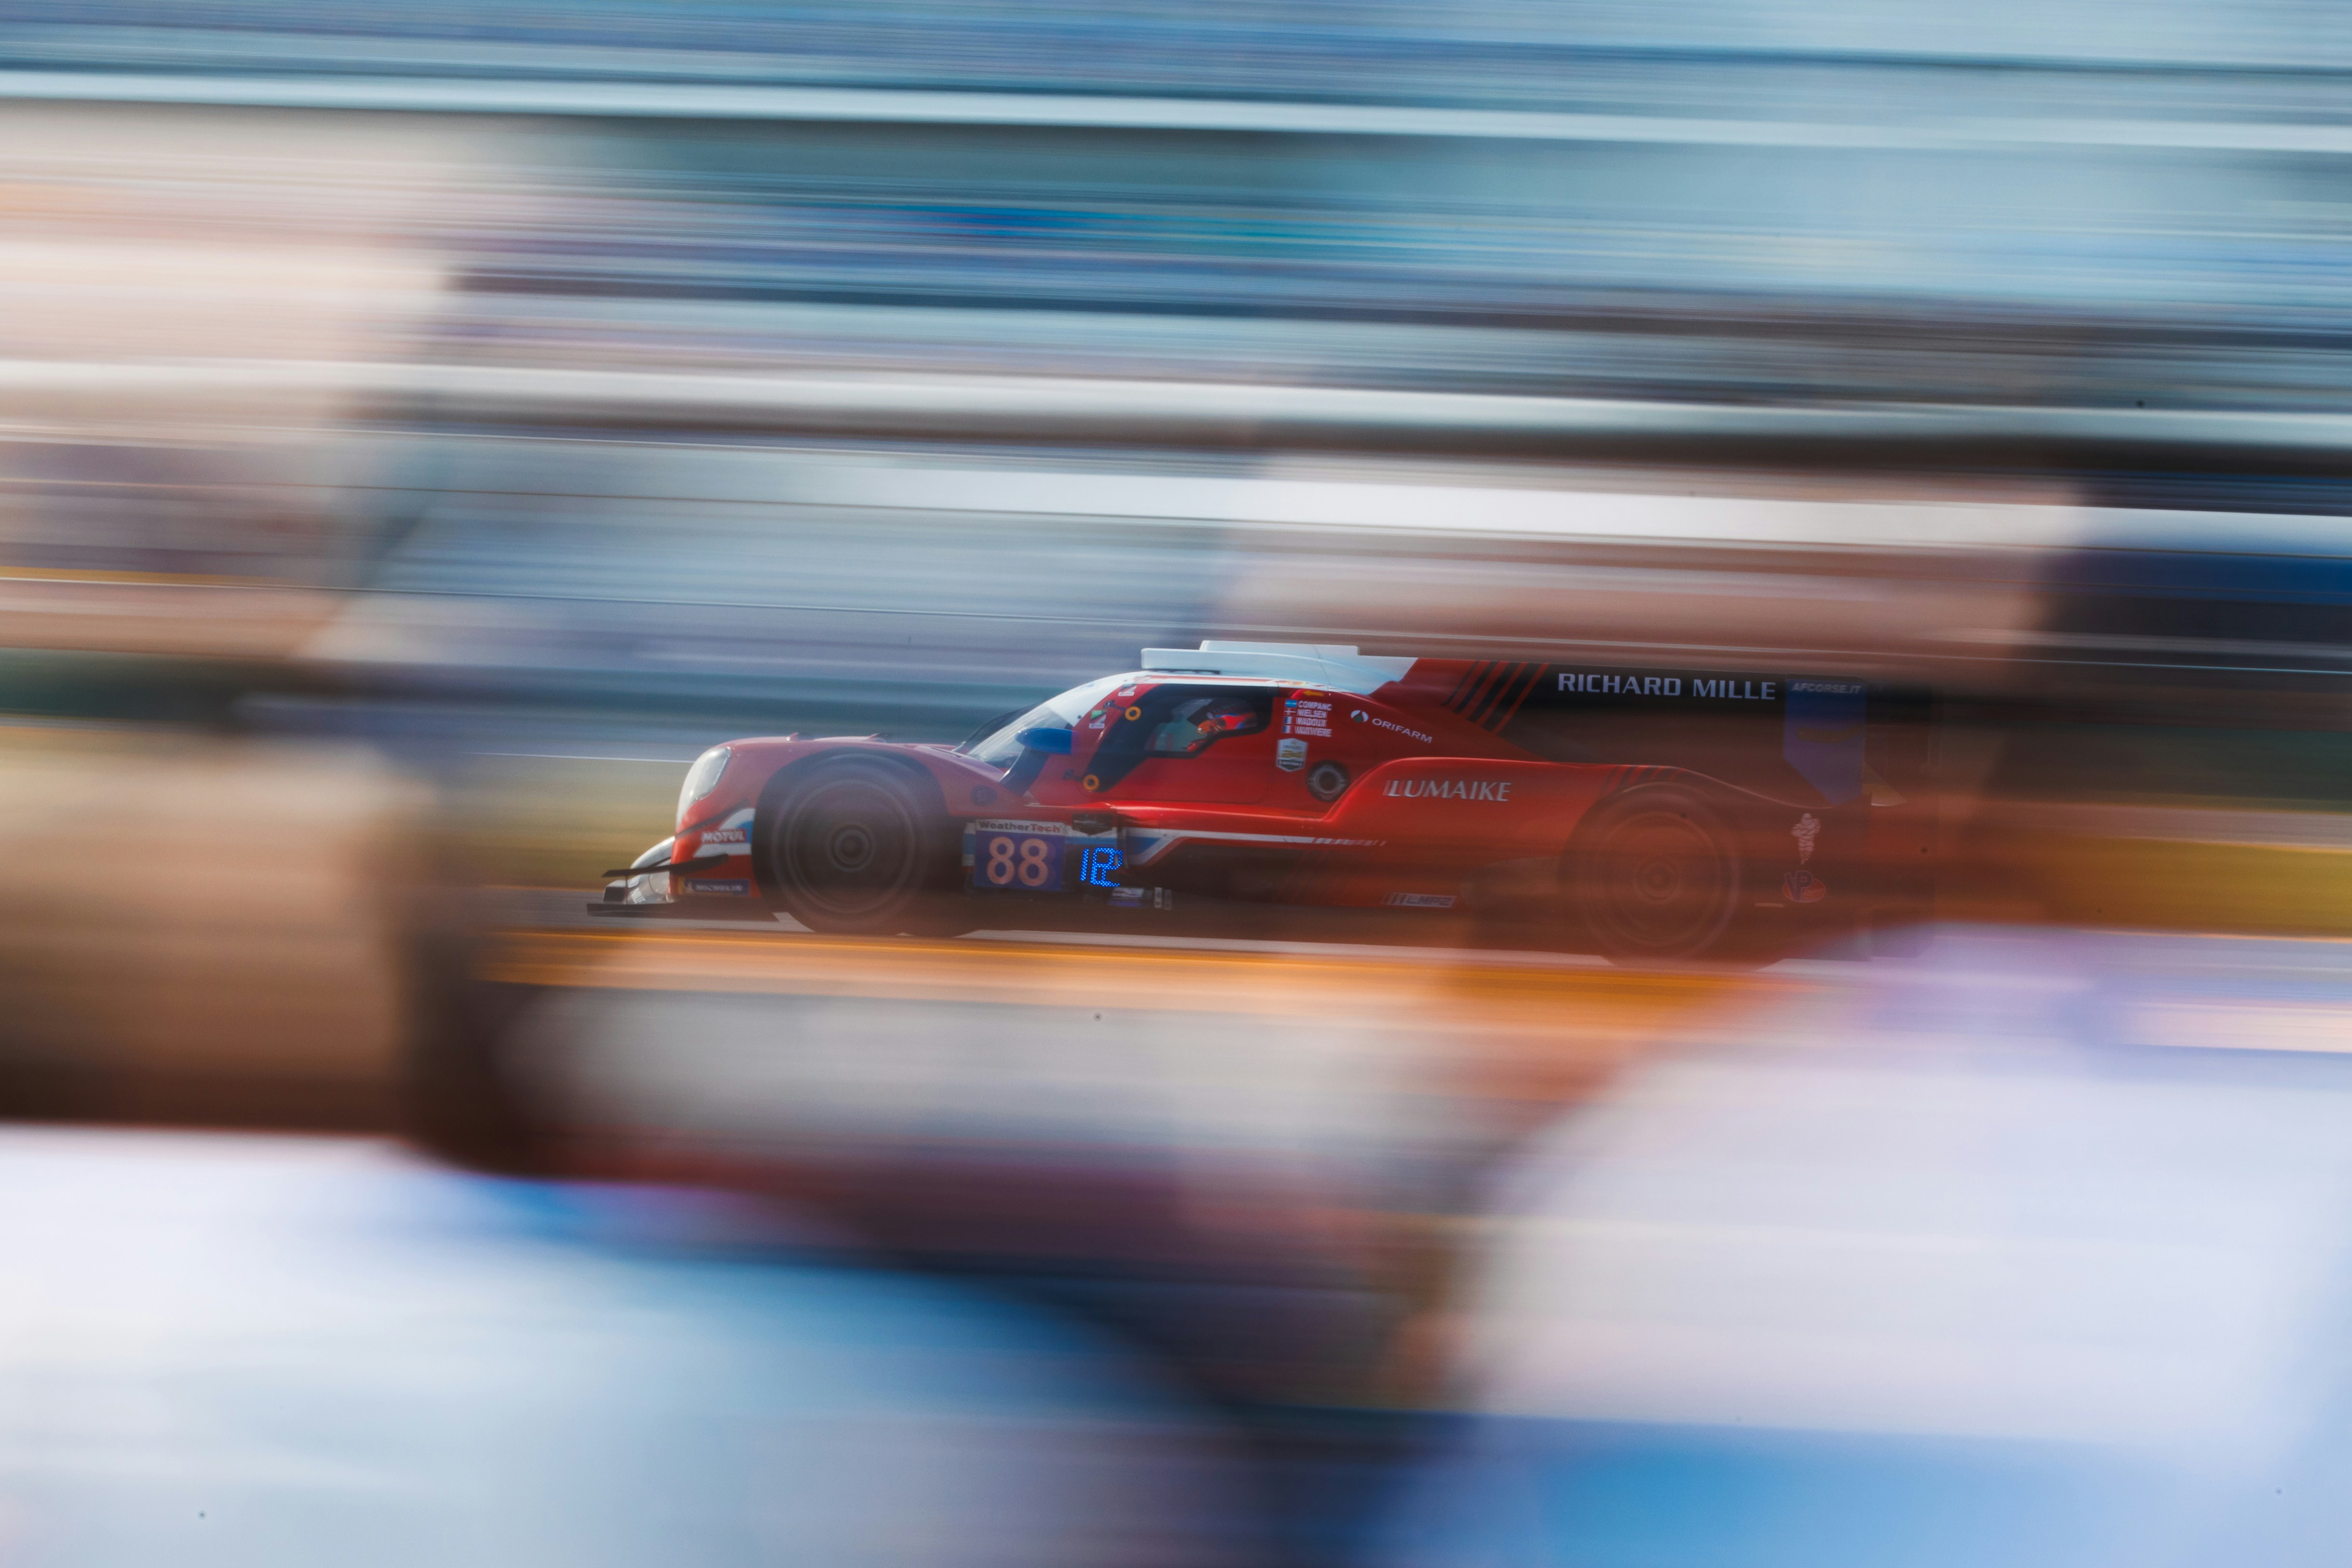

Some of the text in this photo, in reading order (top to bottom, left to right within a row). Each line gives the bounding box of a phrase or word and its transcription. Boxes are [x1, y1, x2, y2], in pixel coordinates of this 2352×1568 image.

[1558, 673, 1776, 700] RICHARD MILLE
[1372, 718, 1432, 743] ORIFARM
[1387, 780, 1511, 801] LUMAIKE
[702, 831, 745, 842] MOTUL
[979, 821, 1060, 832] WeatherTech
[987, 836, 1048, 886] 88
